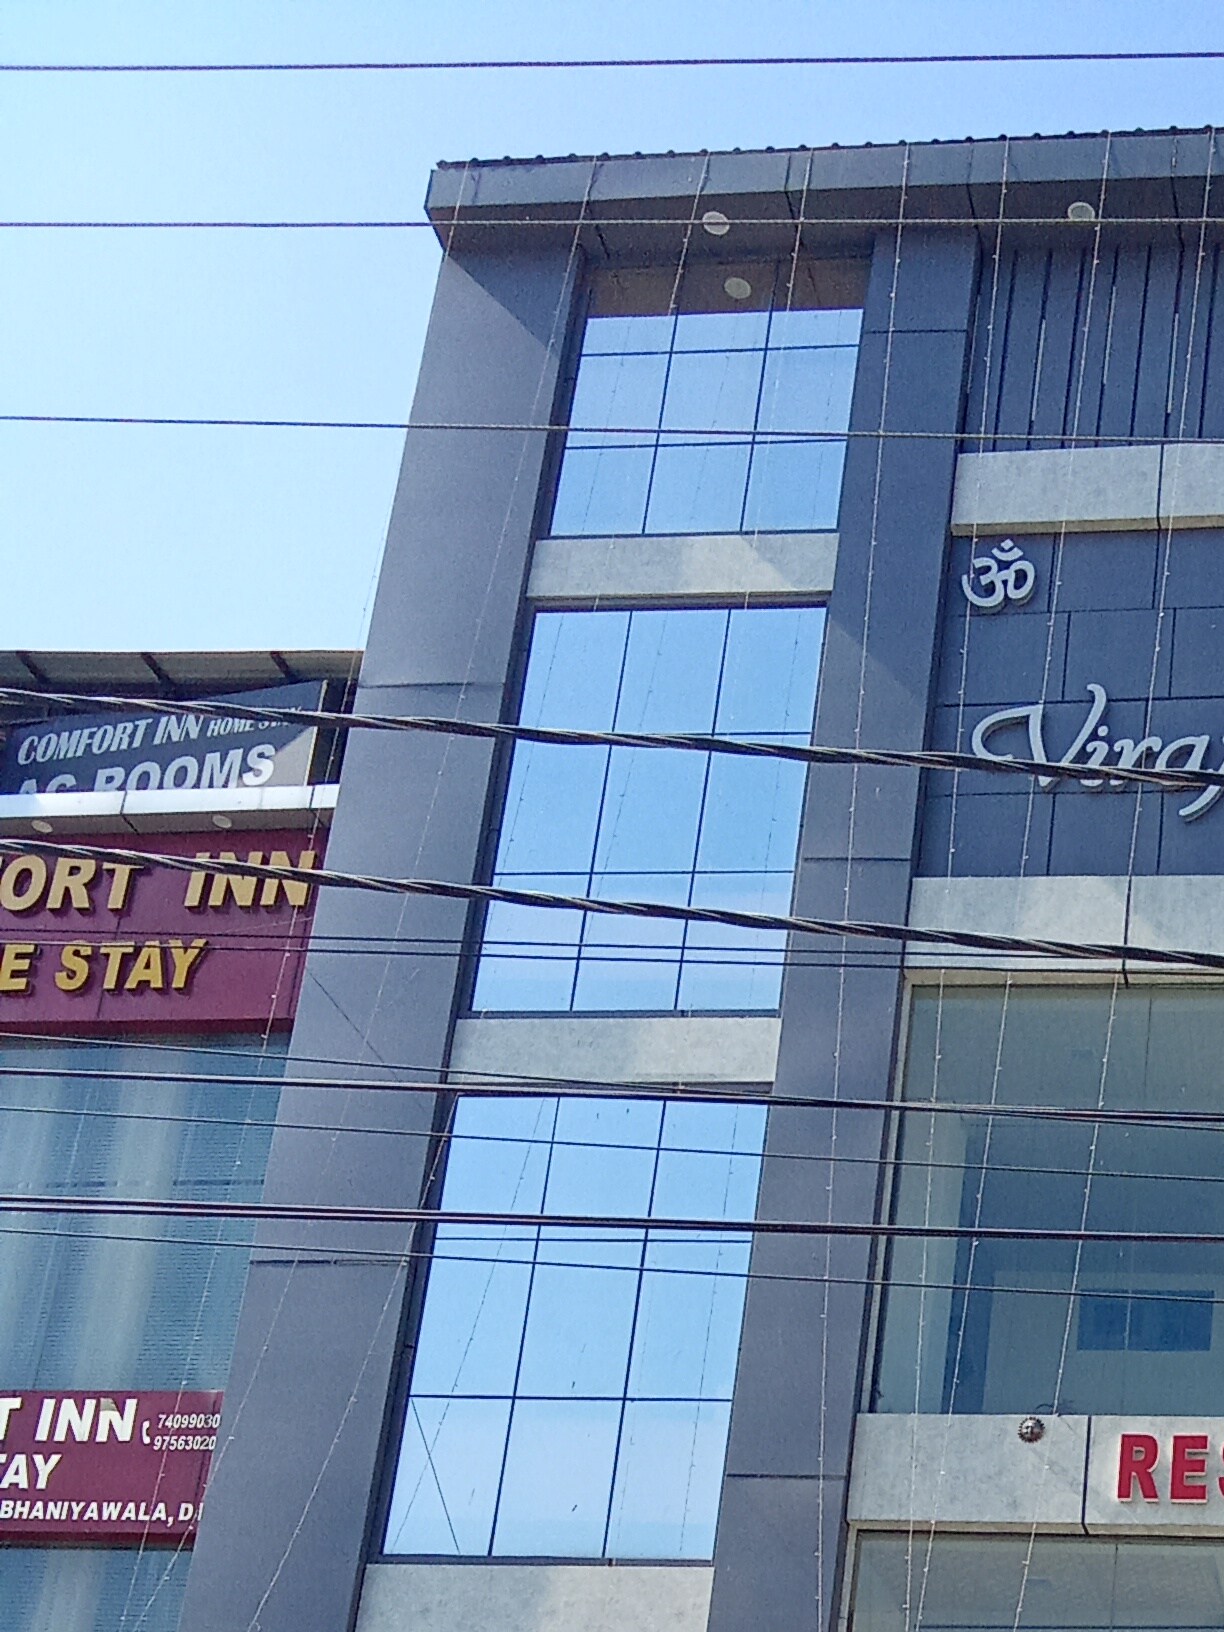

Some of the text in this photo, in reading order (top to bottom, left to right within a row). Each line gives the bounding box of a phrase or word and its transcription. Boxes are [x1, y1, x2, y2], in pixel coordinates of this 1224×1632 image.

[17, 717, 153, 766] COMFORT
[153, 713, 204, 743] INN
[206, 717, 255, 738] HOME
[0, 850, 316, 912] ORT INN
[54, 938, 208, 992] STAY
[35, 1398, 138, 1443] INN
